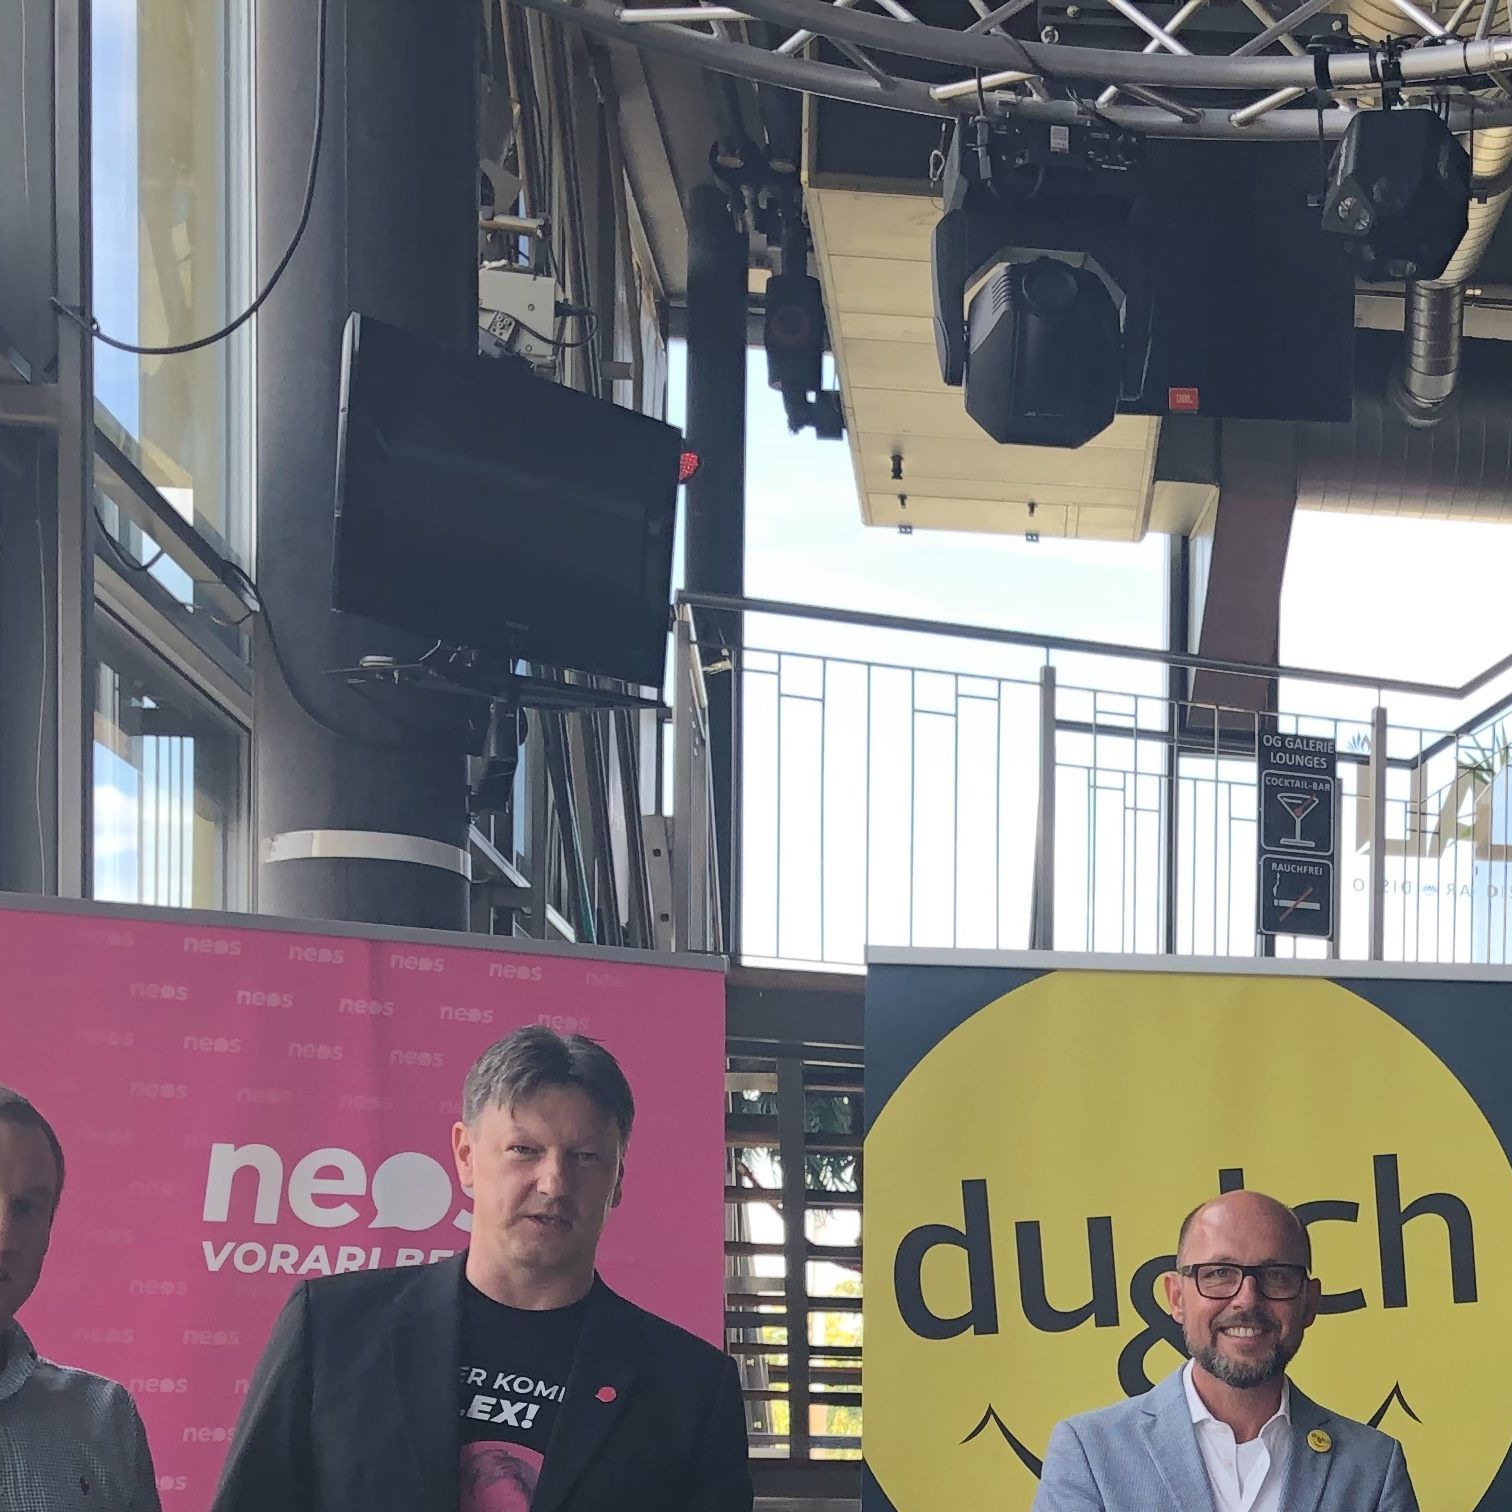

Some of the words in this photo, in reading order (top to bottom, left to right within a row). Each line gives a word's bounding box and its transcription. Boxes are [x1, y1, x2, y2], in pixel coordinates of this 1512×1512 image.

[1262, 734, 1282, 748] OG
[1285, 736, 1335, 754] GALERIE
[1270, 751, 1327, 769] LOUNGES
[1265, 776, 1332, 792] COCKTAIL-BAR
[1271, 862, 1324, 876] RAUCHFREI
[202, 1142, 474, 1233] neo
